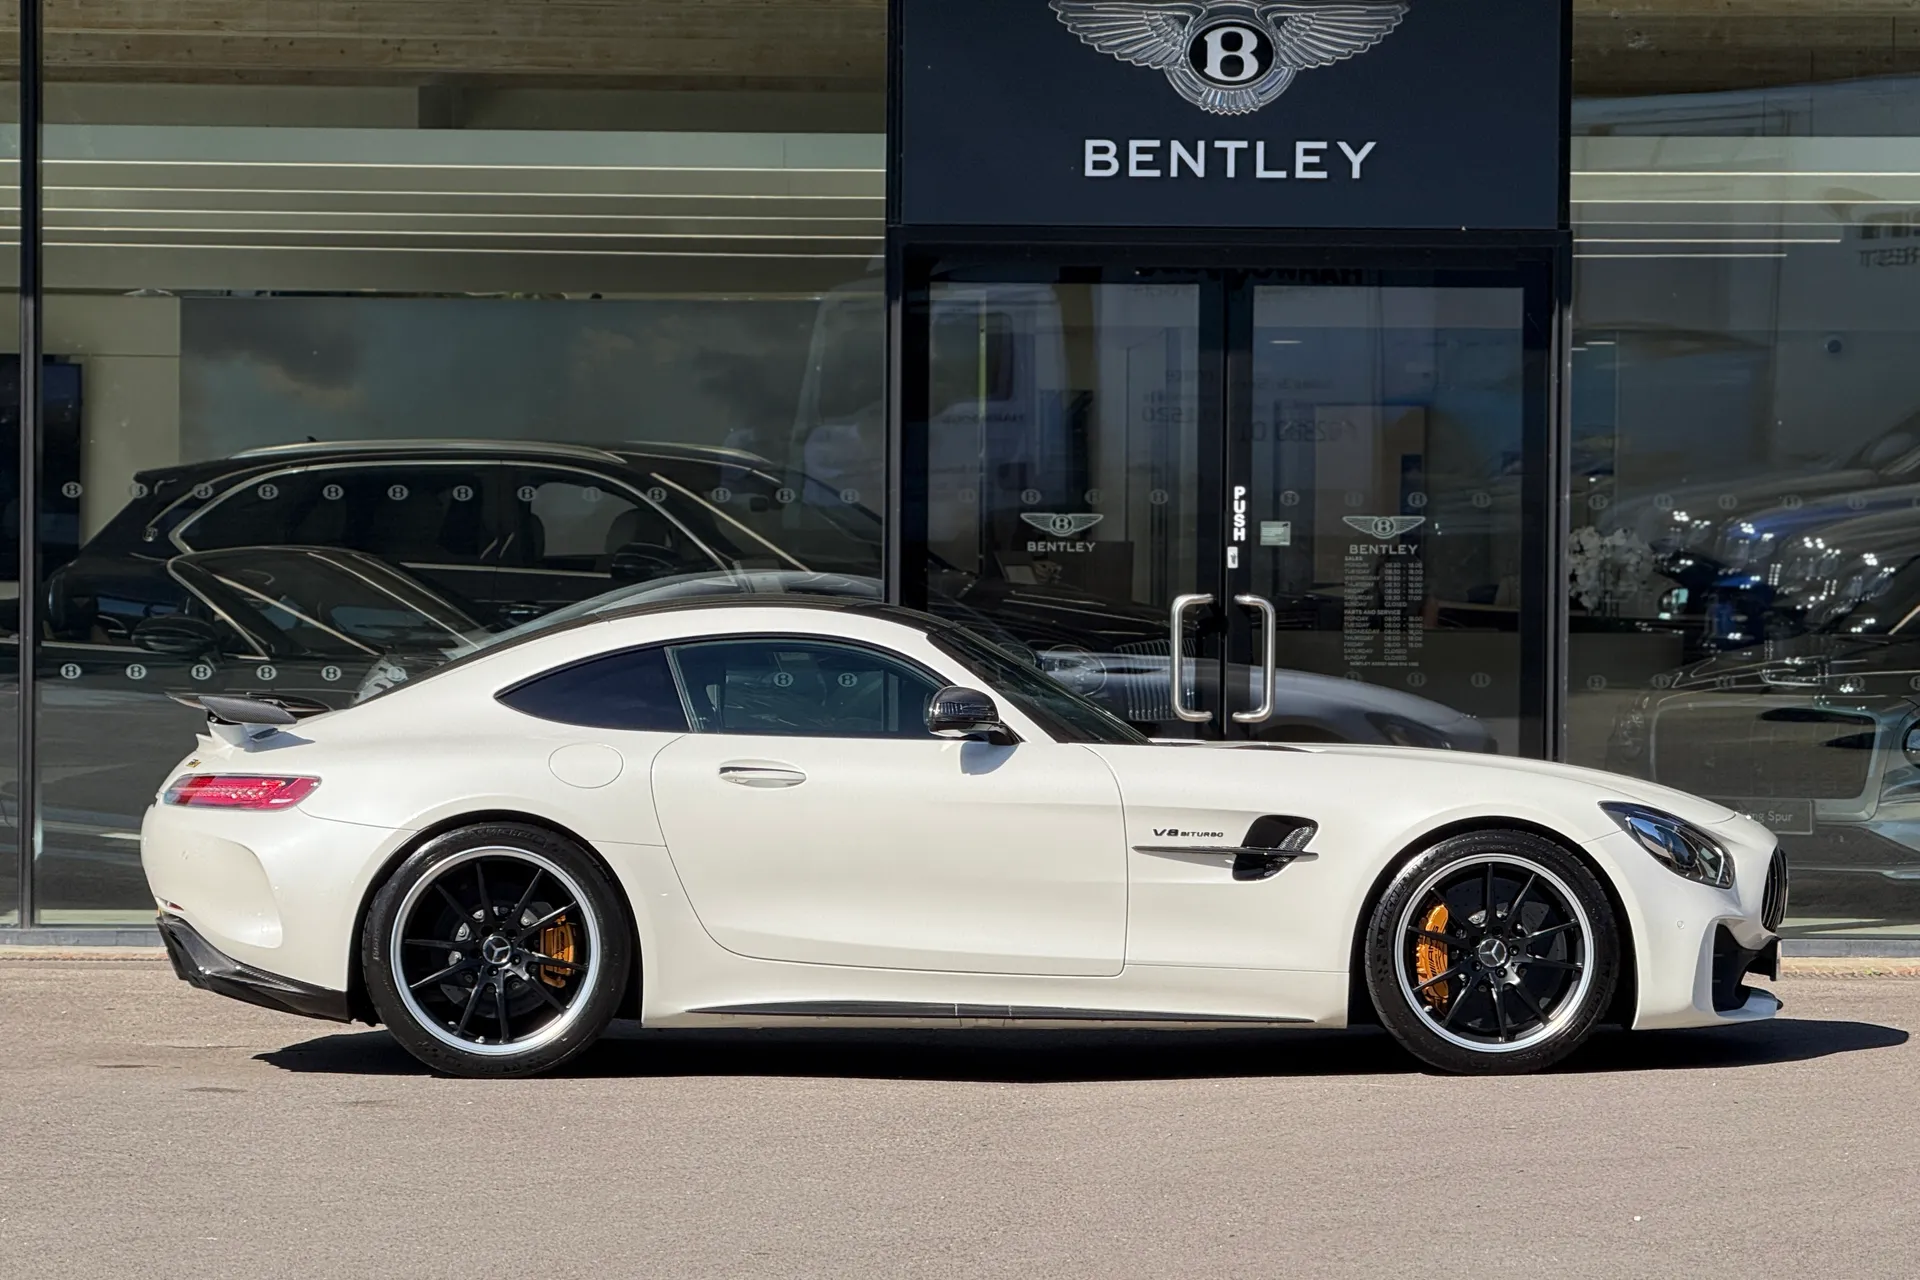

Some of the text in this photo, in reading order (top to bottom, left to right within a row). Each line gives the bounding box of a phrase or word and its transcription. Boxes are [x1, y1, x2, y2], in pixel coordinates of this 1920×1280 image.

[1203, 26, 1259, 82] B
[1084, 139, 1377, 179] BENTLEY
[1233, 485, 1246, 541] PUSH
[1027, 541, 1096, 552] BENTLEY
[1349, 544, 1418, 555] BENTLEY
[1768, 811, 1793, 824] Spur
[1153, 829, 1179, 837] V8
